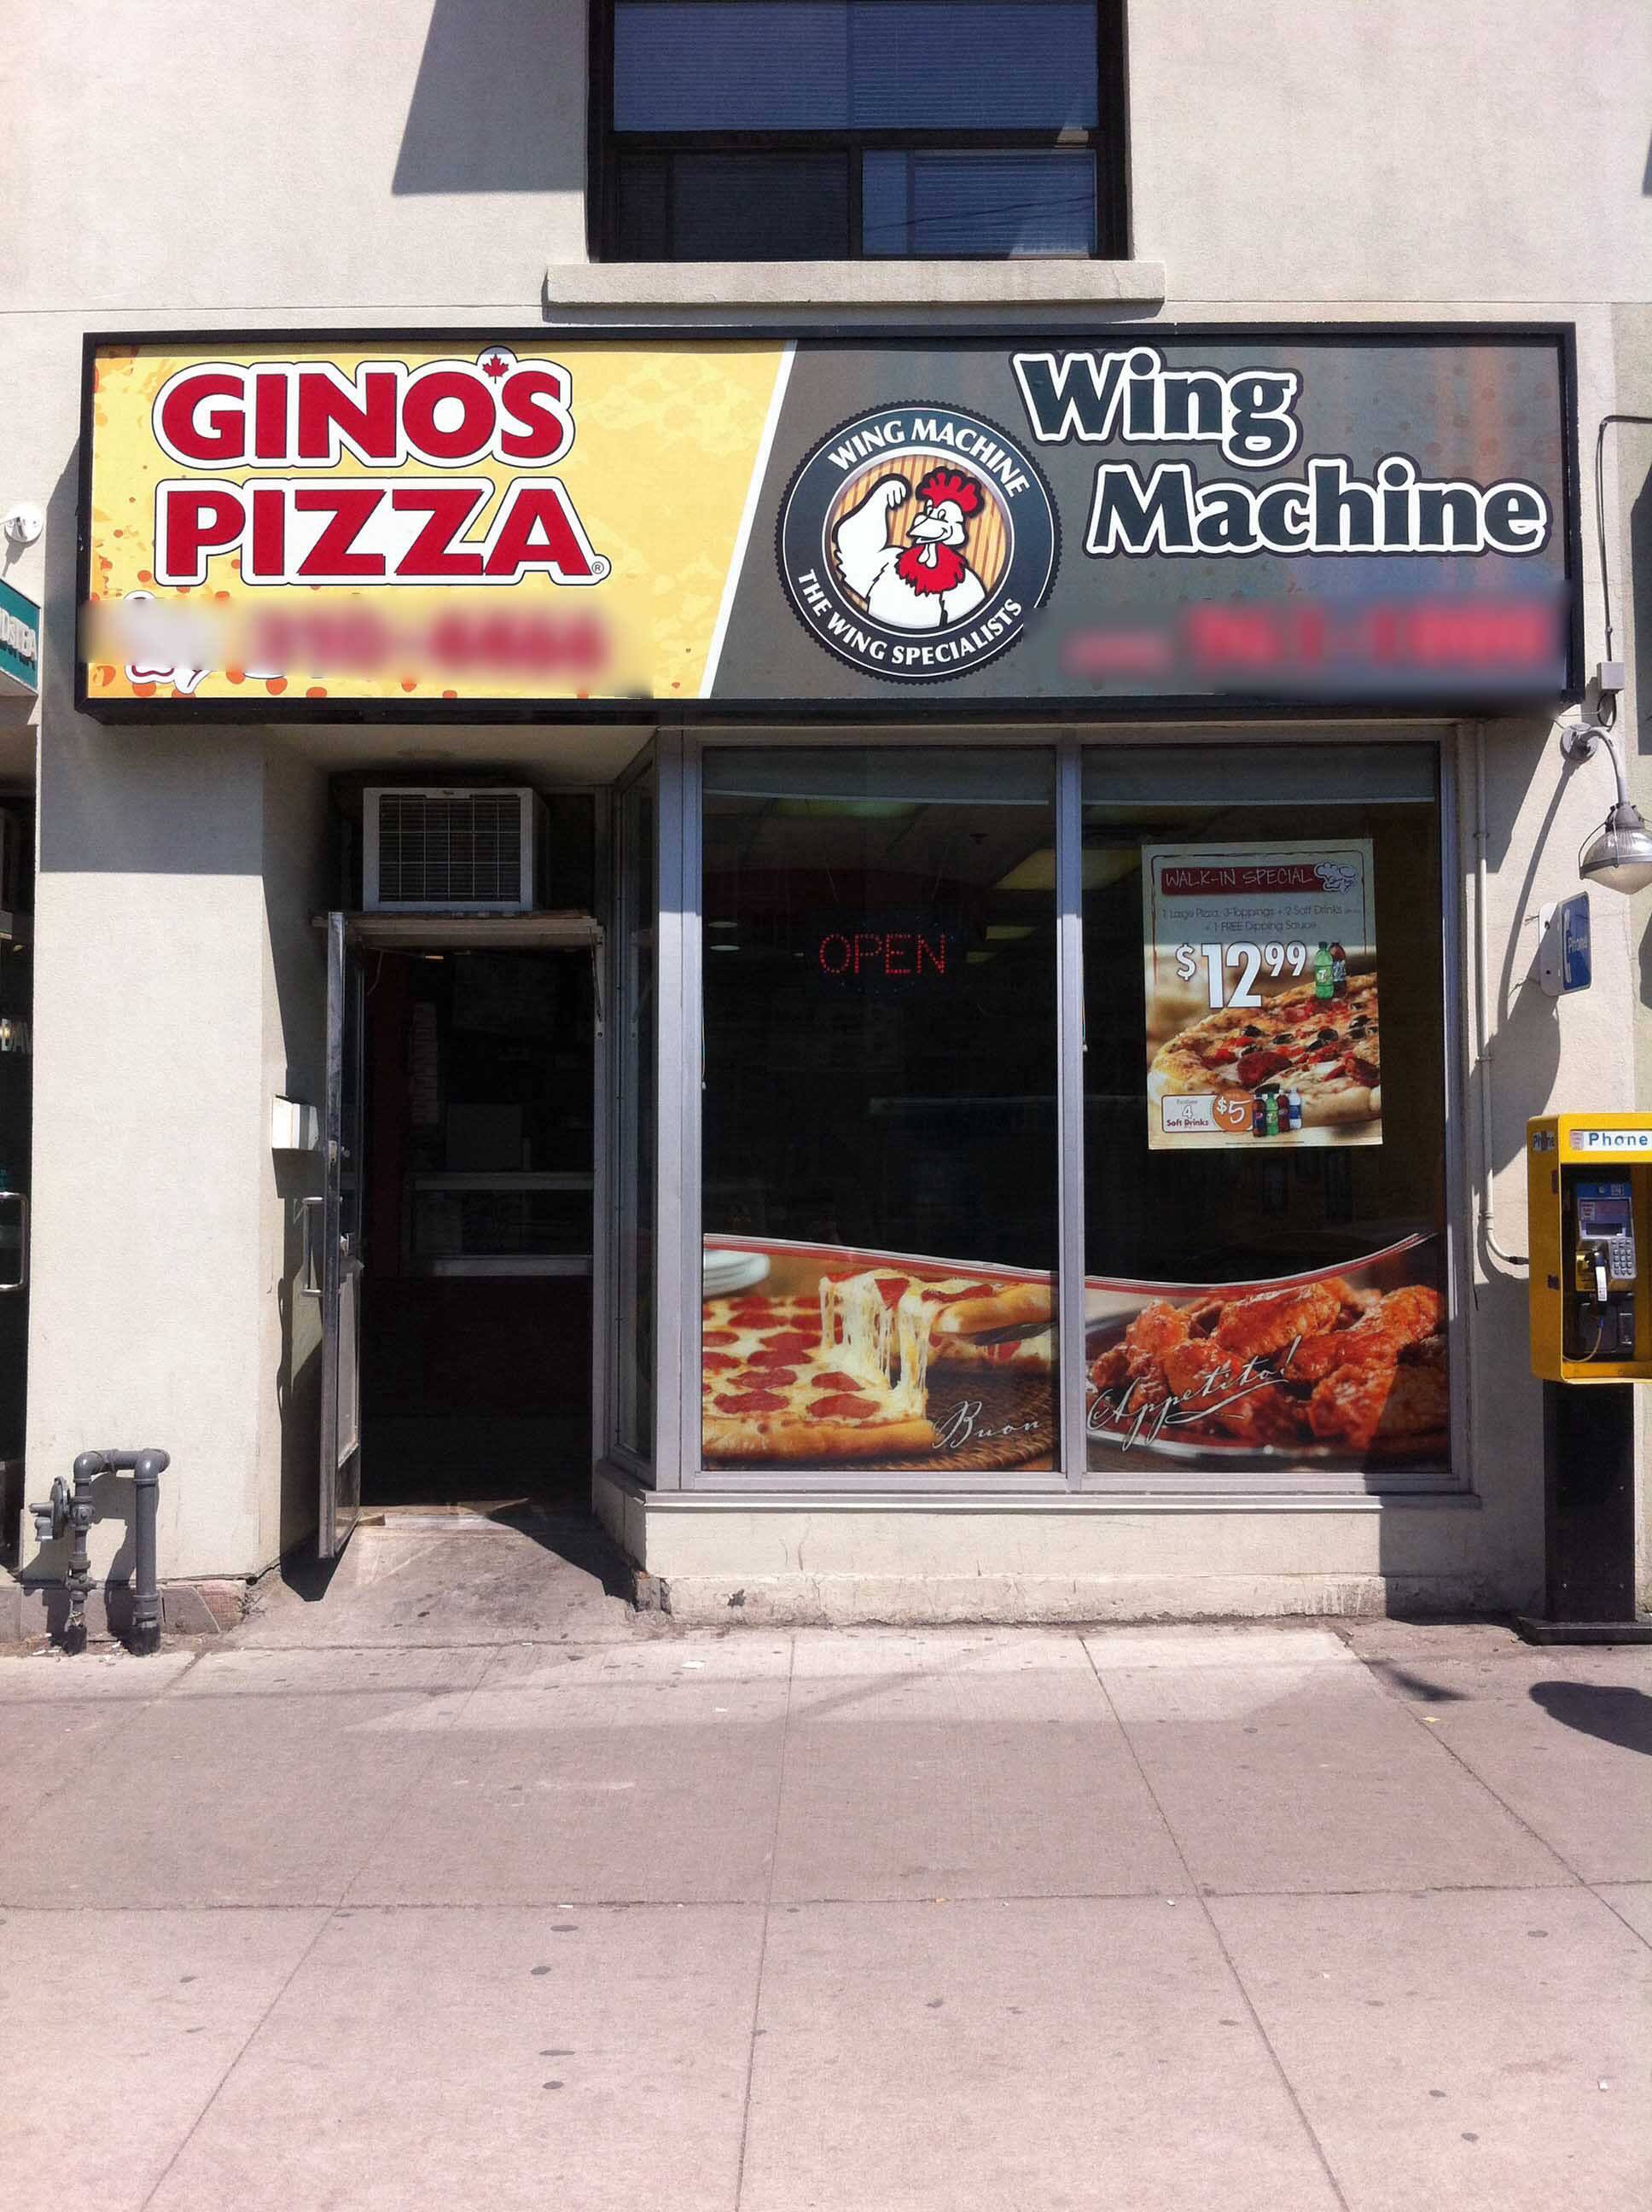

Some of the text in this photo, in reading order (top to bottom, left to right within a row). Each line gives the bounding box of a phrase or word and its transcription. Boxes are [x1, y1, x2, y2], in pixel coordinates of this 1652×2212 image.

[1013, 347, 1298, 468] Wing
[828, 418, 1030, 498] WING MACHINE
[1085, 457, 1546, 554] Machine
[799, 568, 832, 616] THE
[827, 615, 885, 660] WING
[891, 598, 1022, 666] SPECIALISTS
[1166, 867, 1313, 887] WALK-IN SPECIAL
[1170, 910, 1194, 920] Large
[1292, 905, 1312, 916] Soft
[1314, 905, 1342, 915] Drinks
[1221, 922, 1243, 931] FREE
[1245, 921, 1283, 933] Dipping
[1285, 919, 1317, 929] Sauce
[819, 934, 947, 975] OPEN
[1182, 1104, 1193, 1120] 4
[1184, 1118, 1209, 1127] Drinks
[1217, 1097, 1251, 1124] $5
[1589, 1132, 1649, 1146] Phone
[1087, 1334, 1301, 1452] Appetito!
[932, 1400, 1039, 1449] Buon
